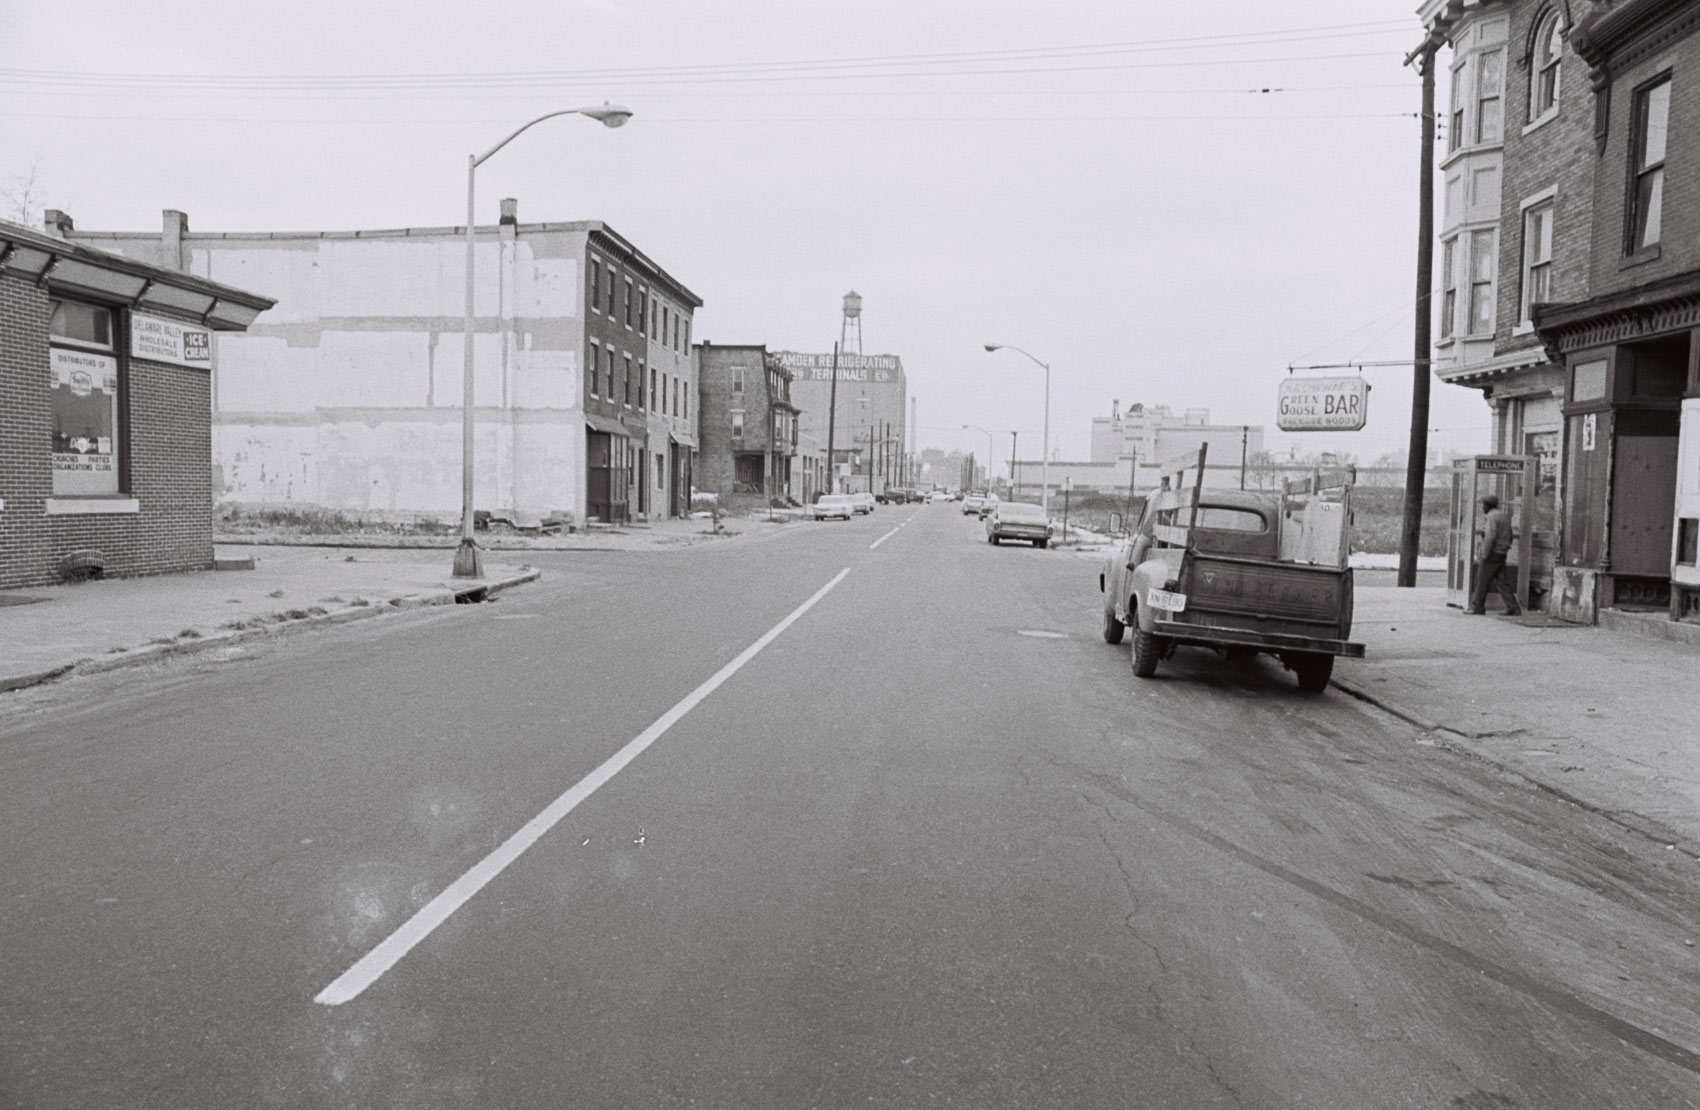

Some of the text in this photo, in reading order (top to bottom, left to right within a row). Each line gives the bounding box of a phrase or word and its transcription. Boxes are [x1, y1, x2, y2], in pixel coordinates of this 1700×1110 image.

[139, 335, 177, 348] WHOLESALE
[189, 334, 204, 346] ICE
[185, 347, 209, 359] CREAM
[58, 354, 97, 367] DISTRIBUTORS
[1324, 394, 1359, 414] BAR
[1324, 417, 1357, 425] GOODS
[88, 455, 110, 464] PARTIES
[1480, 461, 1521, 470] TELEPHONE
